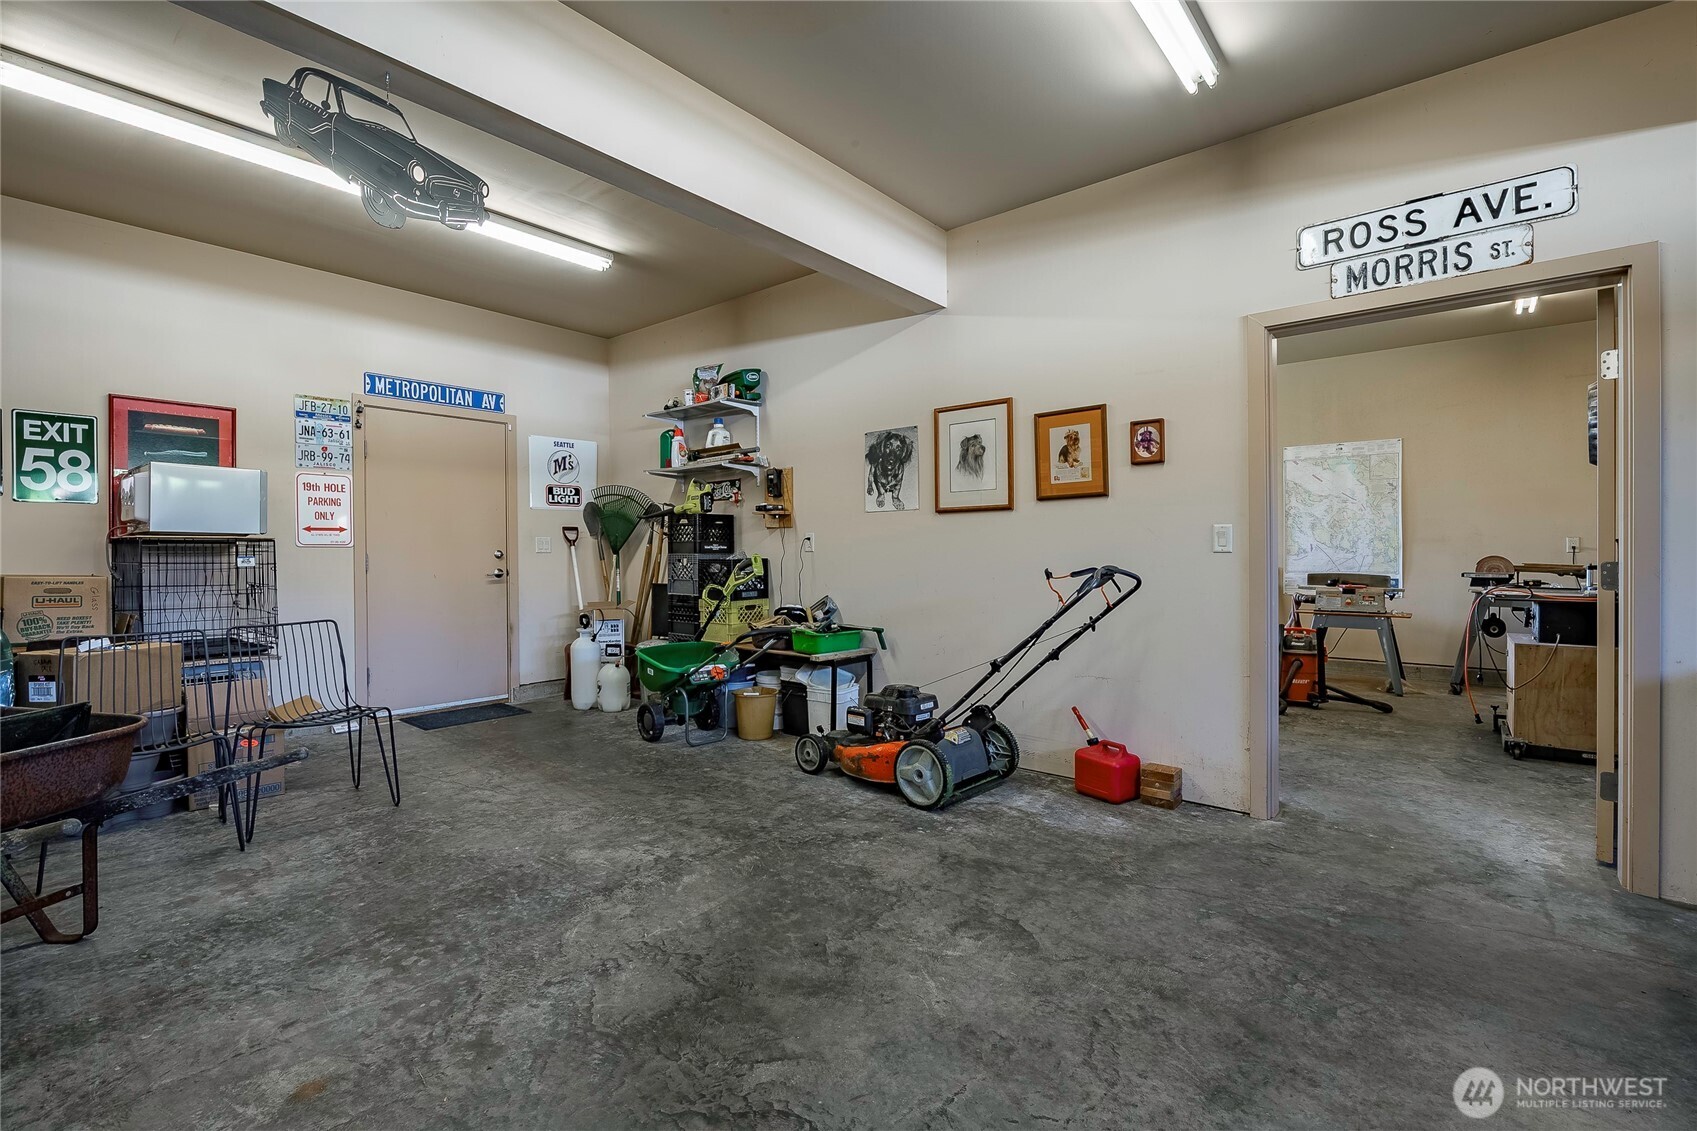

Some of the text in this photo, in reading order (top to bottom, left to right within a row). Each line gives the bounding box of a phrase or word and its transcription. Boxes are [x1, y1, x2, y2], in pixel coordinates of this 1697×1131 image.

[1323, 181, 1552, 256] ROSS AVE.
[1346, 239, 1516, 293] MORRIS ST.
[375, 376, 497, 410] METROPOLITAN AV
[299, 400, 348, 415] JFB-27-10
[23, 419, 88, 444] EXIT
[299, 425, 350, 440] JNA-63-61
[553, 441, 575, 449] SEATTLE
[298, 450, 350, 463] JRB-99-74
[20, 447, 92, 493] 58
[553, 454, 574, 476] M's
[302, 482, 346, 493] 19th HOLE
[552, 487, 575, 496] BUD
[307, 497, 342, 507] PARKING
[548, 494, 579, 504] LIGHT
[314, 511, 335, 521] ONLY
[22, 616, 48, 627] 100%
